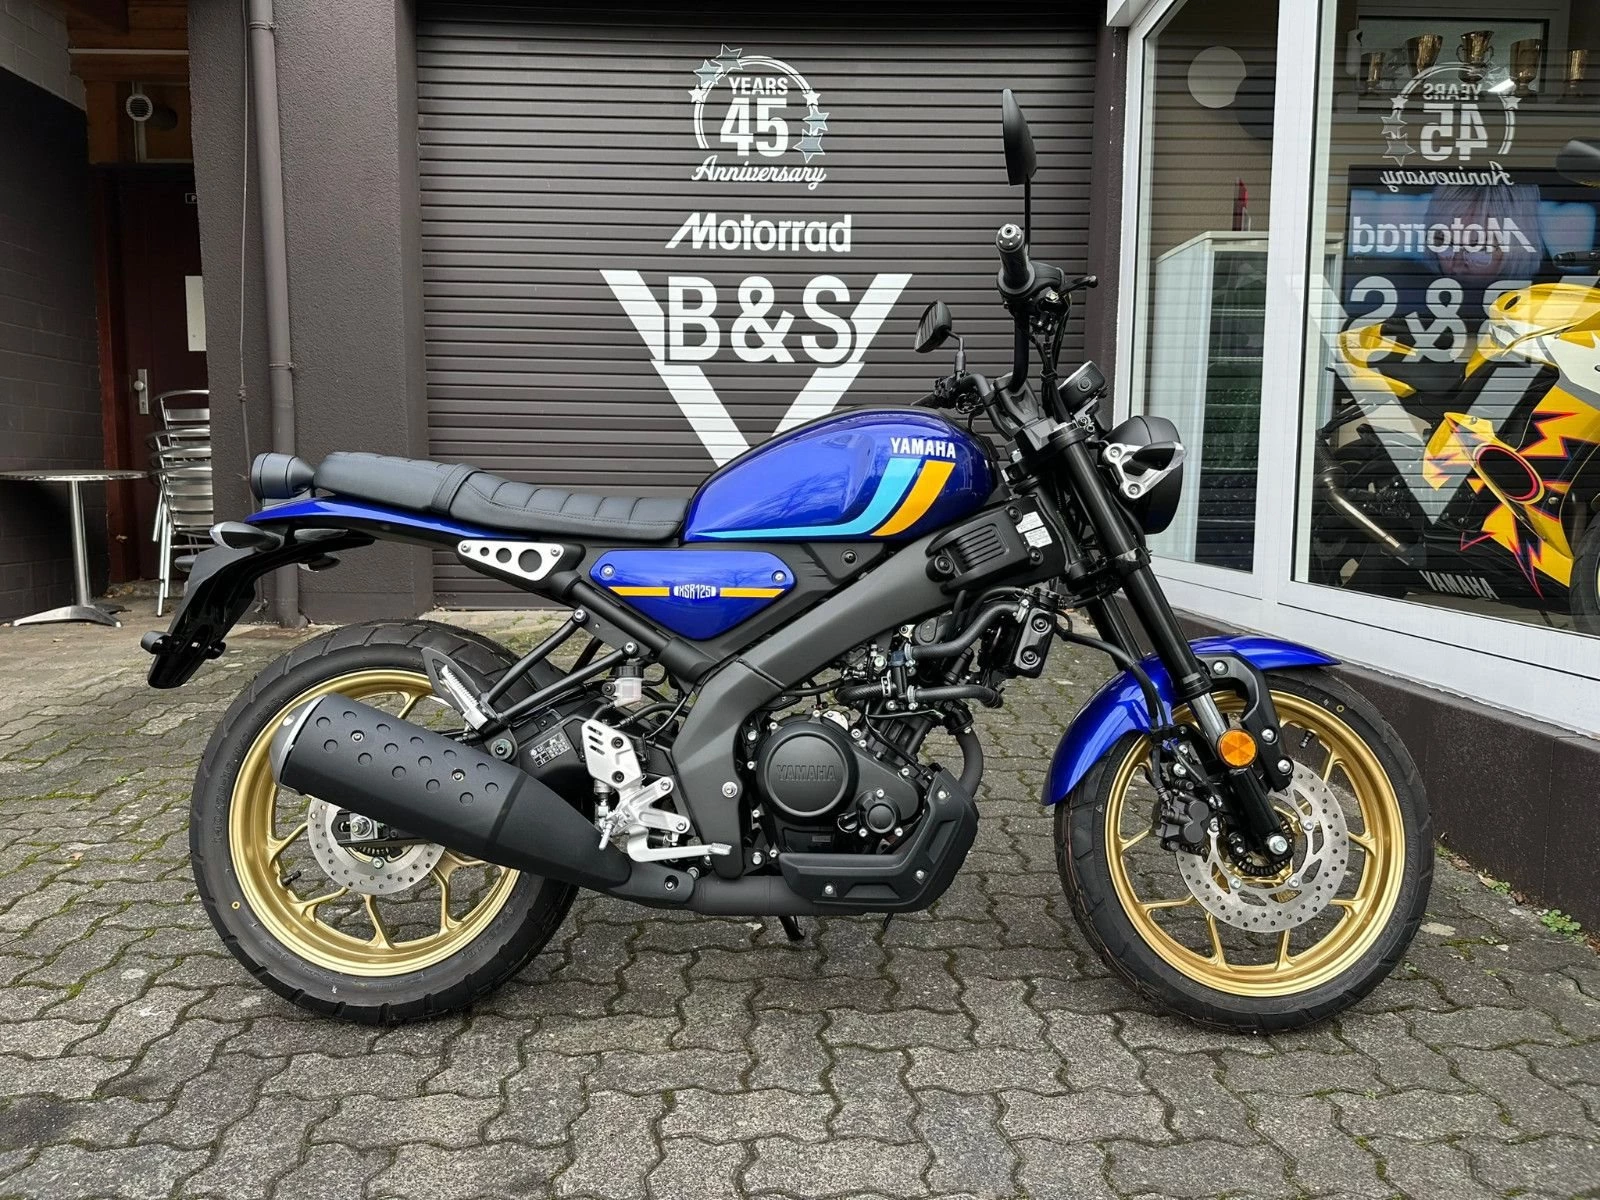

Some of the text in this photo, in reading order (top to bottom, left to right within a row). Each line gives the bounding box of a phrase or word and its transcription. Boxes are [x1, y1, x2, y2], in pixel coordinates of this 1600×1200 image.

[729, 77, 788, 96] YEARS
[719, 98, 789, 157] 45
[691, 155, 827, 190] Anniversary
[665, 212, 852, 253] Motorrad
[667, 275, 852, 363] B&S
[890, 437, 957, 459] YAMAHA
[679, 583, 711, 600] XSR125
[1418, 569, 1500, 600] YAMAHA
[776, 764, 836, 781] YAMAHA
